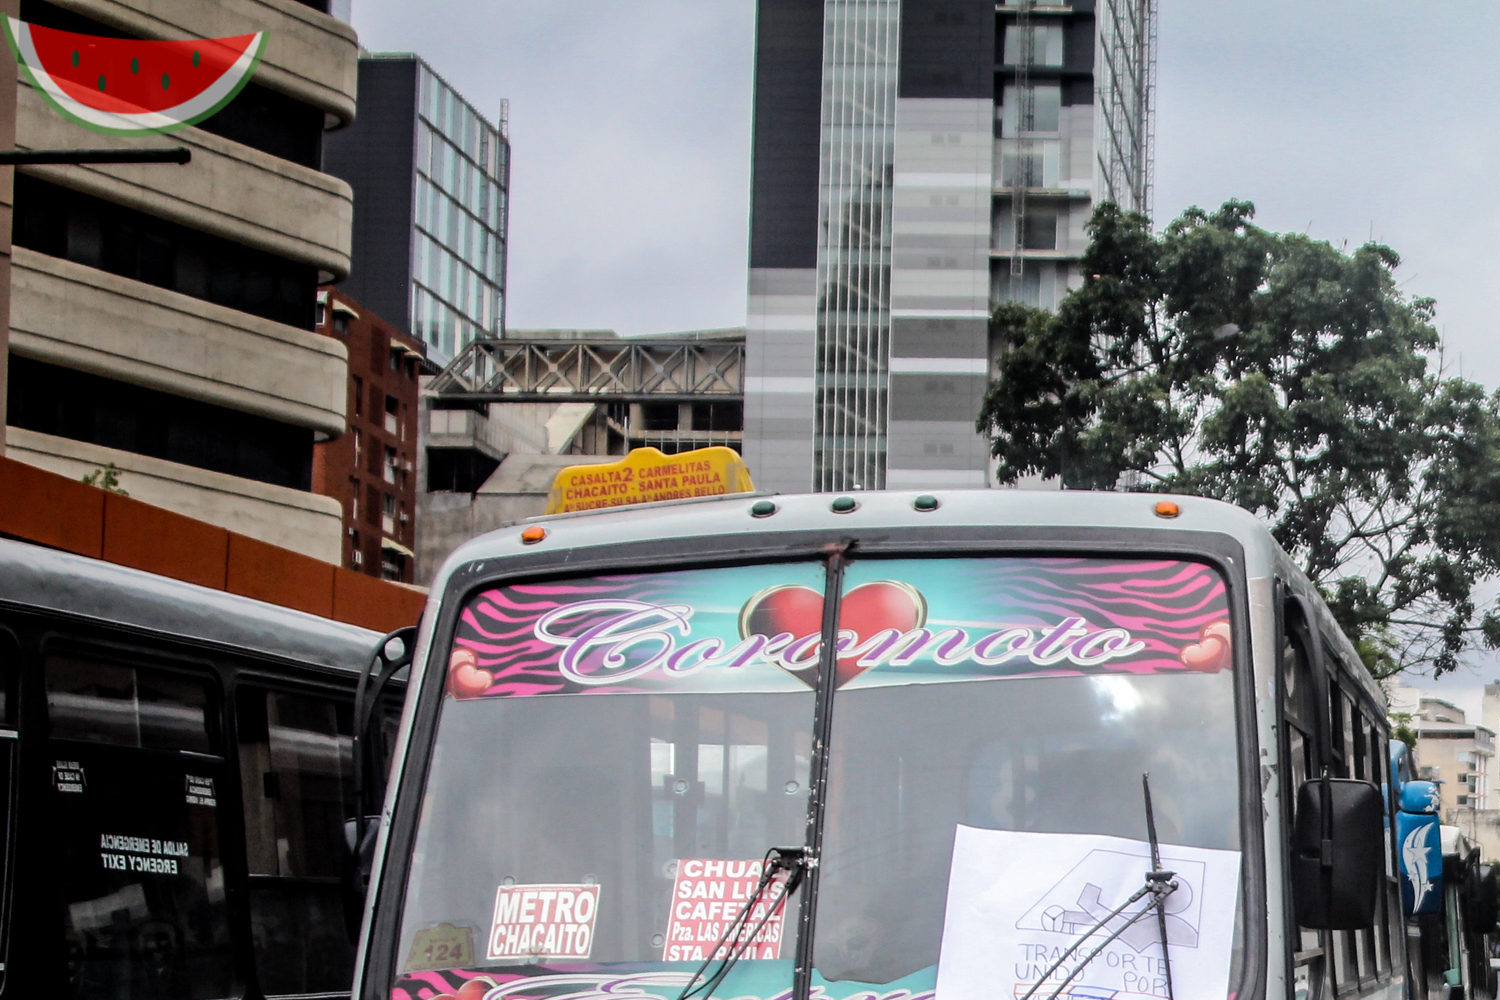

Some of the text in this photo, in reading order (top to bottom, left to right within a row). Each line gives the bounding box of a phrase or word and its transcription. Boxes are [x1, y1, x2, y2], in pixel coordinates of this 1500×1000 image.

[566, 482, 628, 499] CHACAITO
[638, 476, 679, 492] SANTA
[682, 472, 721, 487] PAULA
[570, 460, 711, 487] CASALTA 2 CARMELITAS
[653, 488, 691, 502] ANDRES
[694, 484, 725, 498] BELLO
[534, 598, 1145, 685] Coromoto
[677, 880, 726, 899] SAN
[496, 890, 596, 925] METRO
[493, 924, 590, 955] CHACAITO
[671, 921, 694, 941] Pza.
[697, 921, 720, 942] LAS
[425, 943, 464, 962] 124
[1017, 943, 1173, 976] TRANSPORTE
[1014, 963, 1169, 993] UNIDO POR
